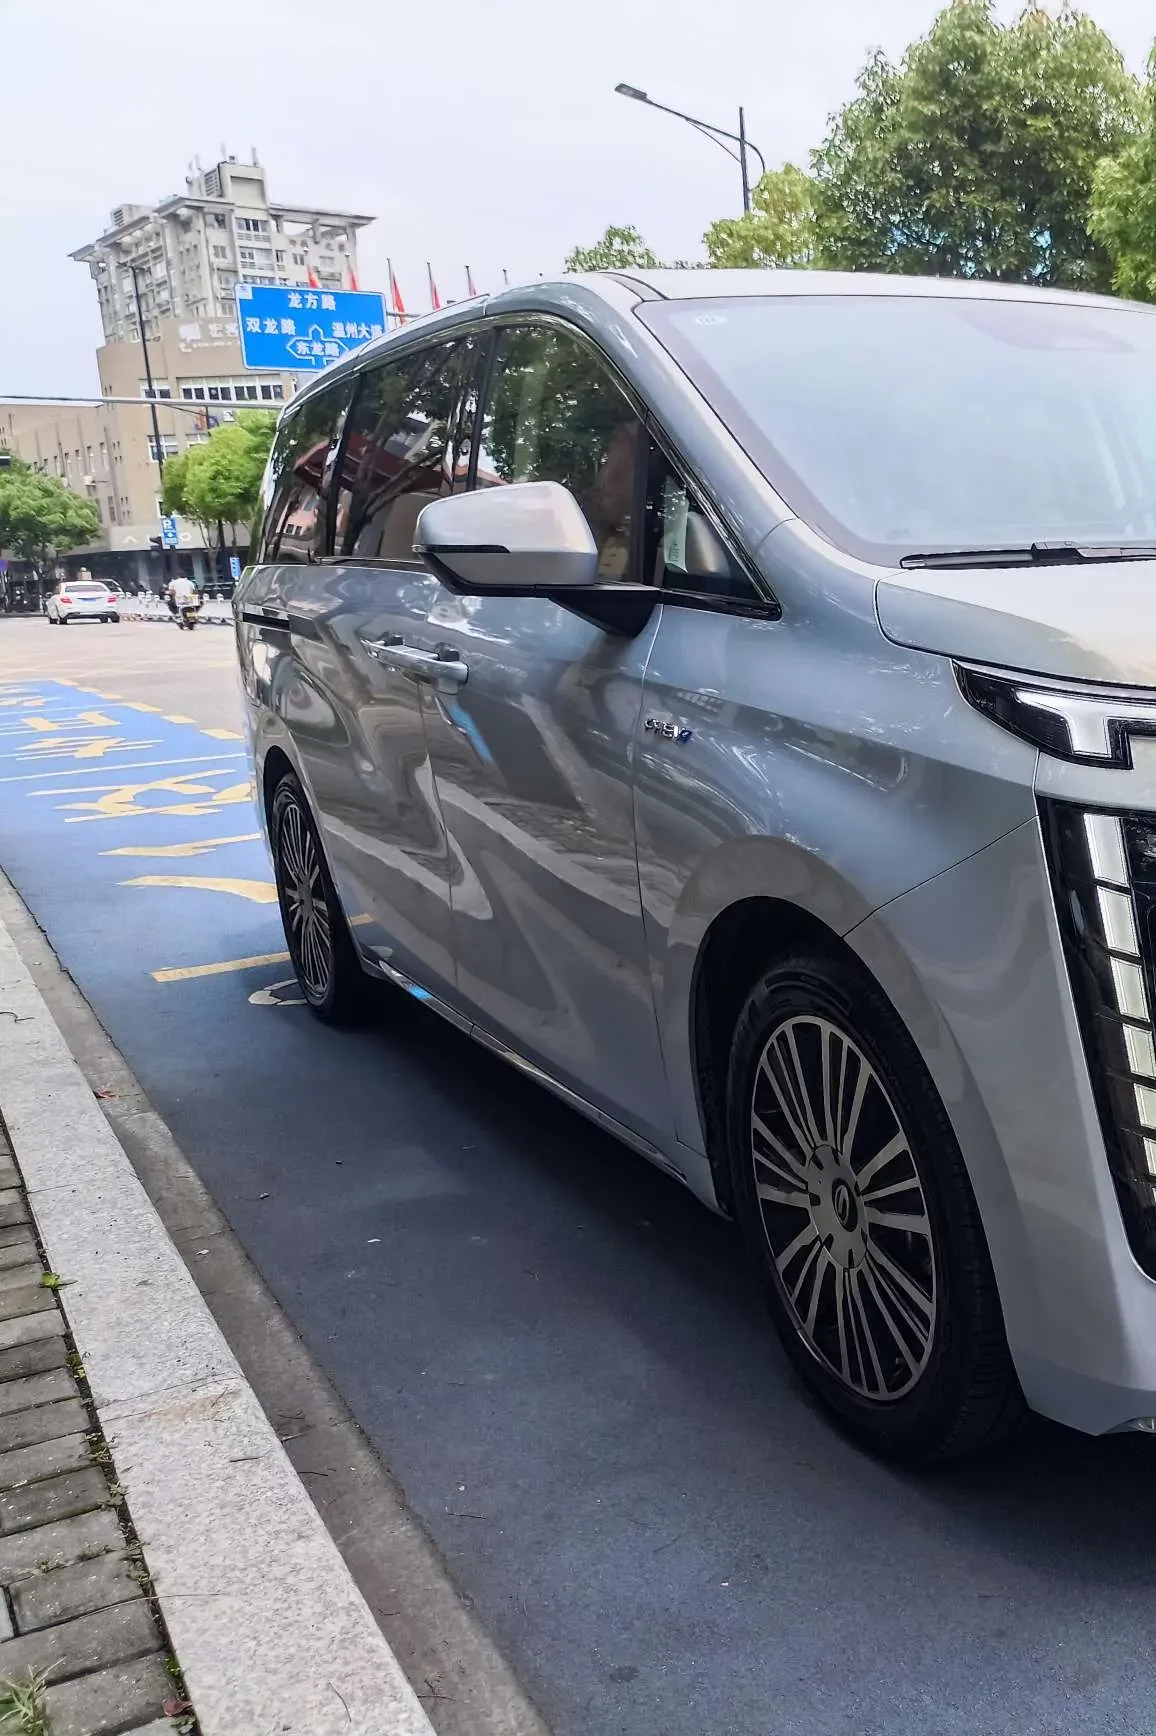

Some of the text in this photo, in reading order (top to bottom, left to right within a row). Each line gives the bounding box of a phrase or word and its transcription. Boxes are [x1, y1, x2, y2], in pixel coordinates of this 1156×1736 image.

[287, 292, 336, 311] 龙方路
[246, 317, 297, 335] 双龙路
[332, 321, 383, 339] 温州大道
[296, 341, 340, 357] 东龙路
[163, 520, 172, 530] P
